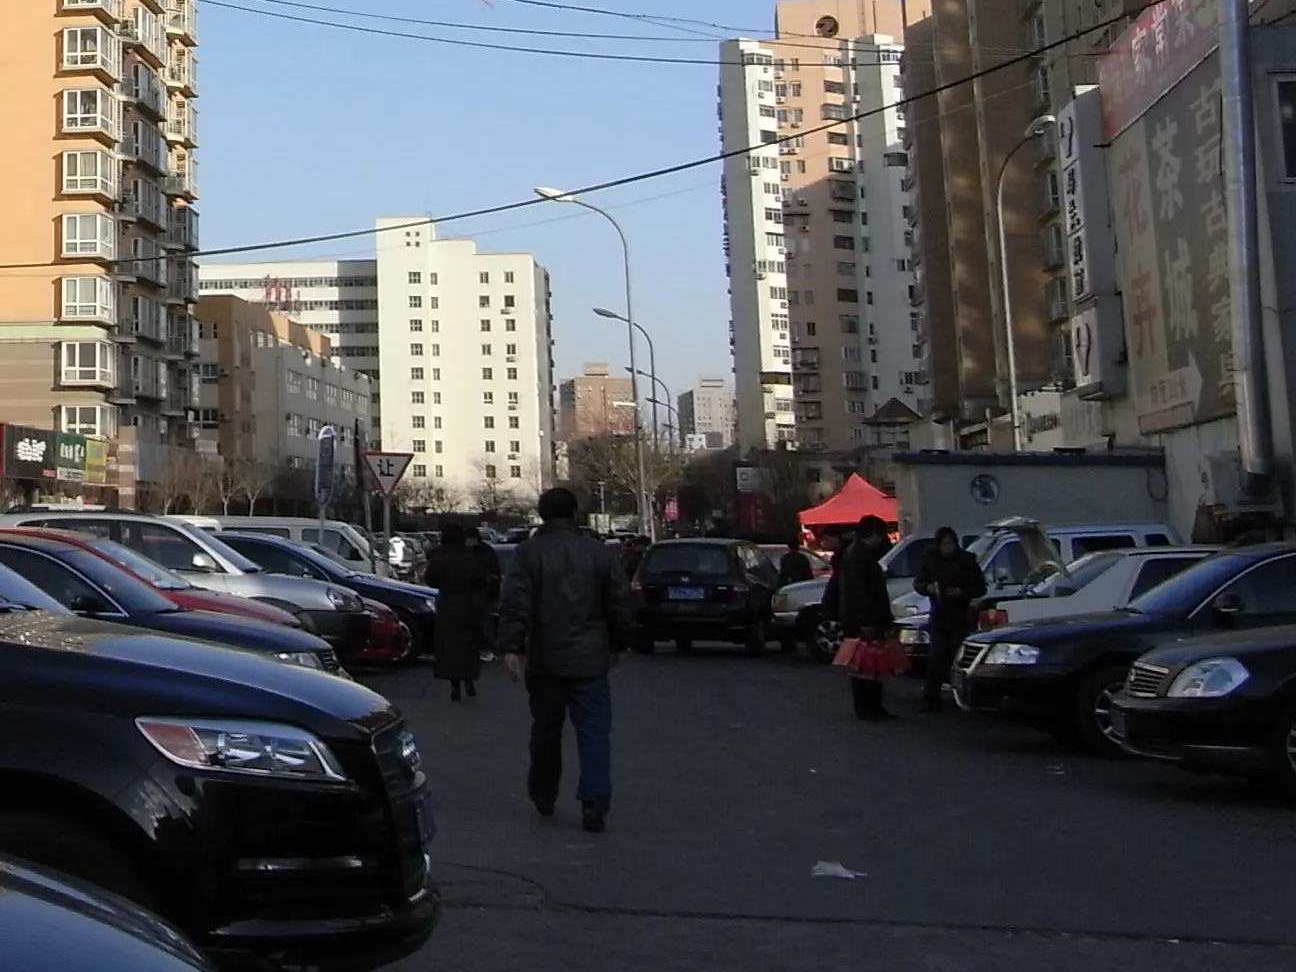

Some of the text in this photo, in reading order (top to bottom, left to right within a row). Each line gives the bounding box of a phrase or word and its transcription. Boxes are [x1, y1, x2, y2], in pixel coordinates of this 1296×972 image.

[1119, 146, 1158, 360] 花卉
[1151, 114, 1200, 343] 茶城
[376, 458, 396, 477] 让
